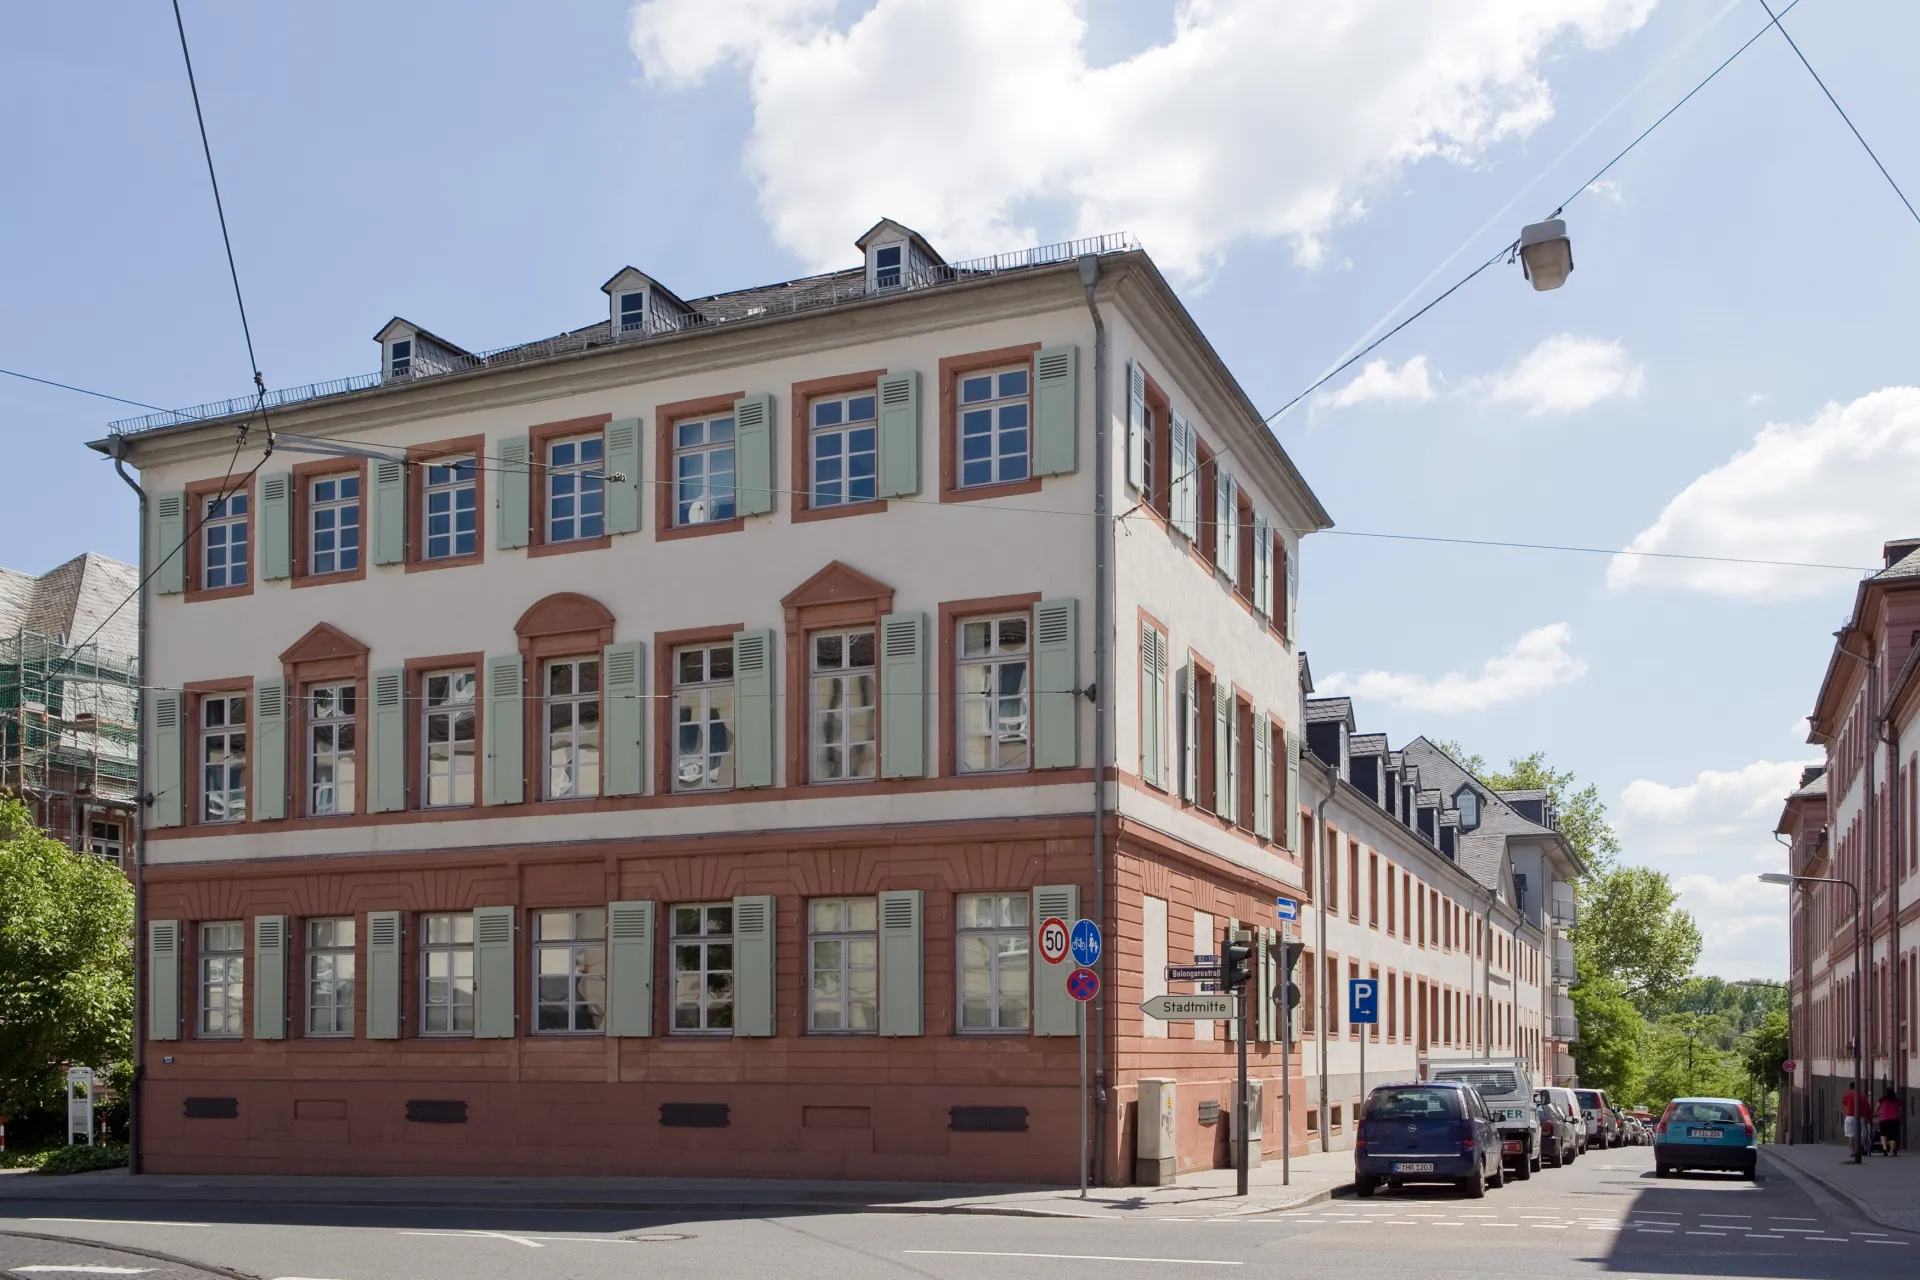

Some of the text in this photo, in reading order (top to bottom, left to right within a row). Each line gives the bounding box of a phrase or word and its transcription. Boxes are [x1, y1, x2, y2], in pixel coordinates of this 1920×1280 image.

[1046, 930, 1063, 951] 50
[1172, 969, 1221, 979] Bolongarostraß
[1354, 983, 1372, 1009] P
[1163, 1001, 1226, 1012] Stadtmitte
